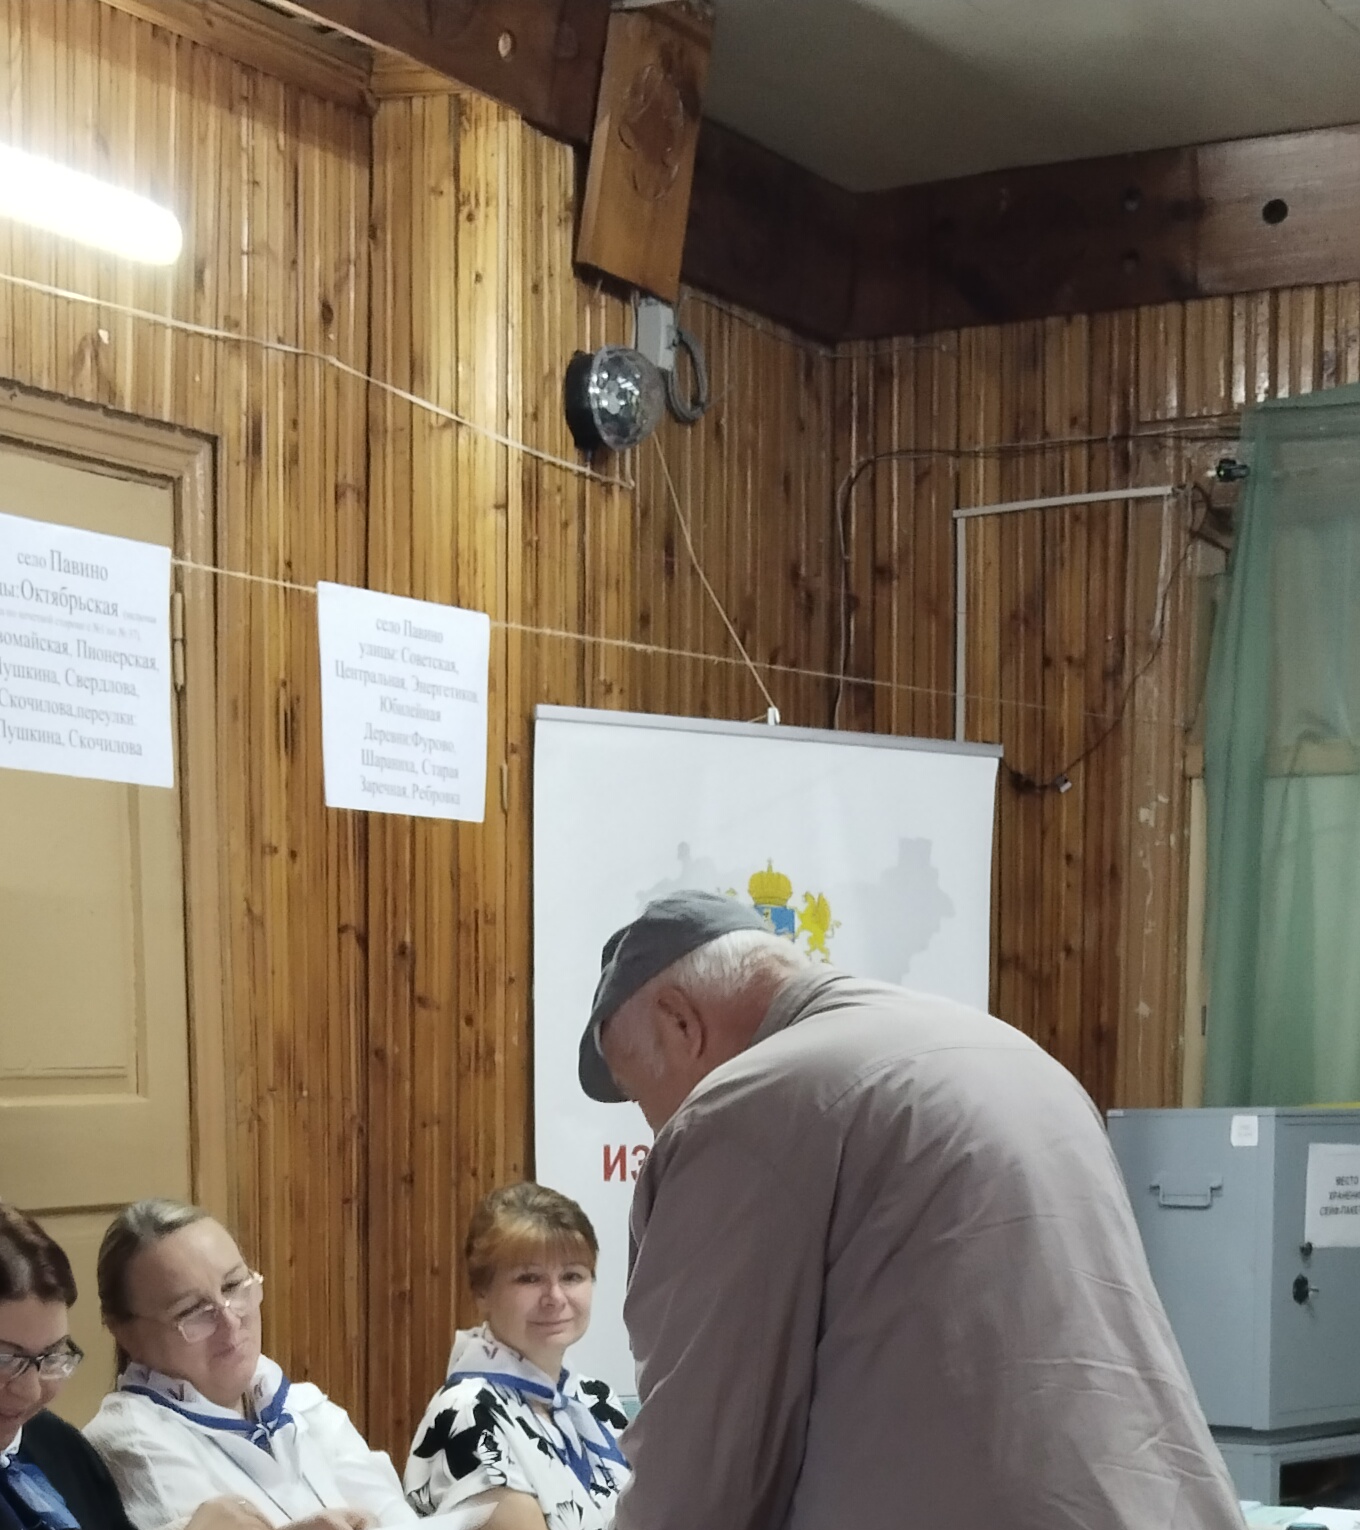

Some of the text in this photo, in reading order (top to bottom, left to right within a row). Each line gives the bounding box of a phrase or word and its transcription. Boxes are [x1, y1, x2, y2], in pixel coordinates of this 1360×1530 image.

[17, 549, 109, 582] село Павино
[376, 618, 444, 643] село Павино
[76, 639, 160, 672] Пионерская,
[401, 647, 459, 674] Советская,
[65, 668, 139, 698] Свердлова,
[68, 728, 143, 756] Скочилова
